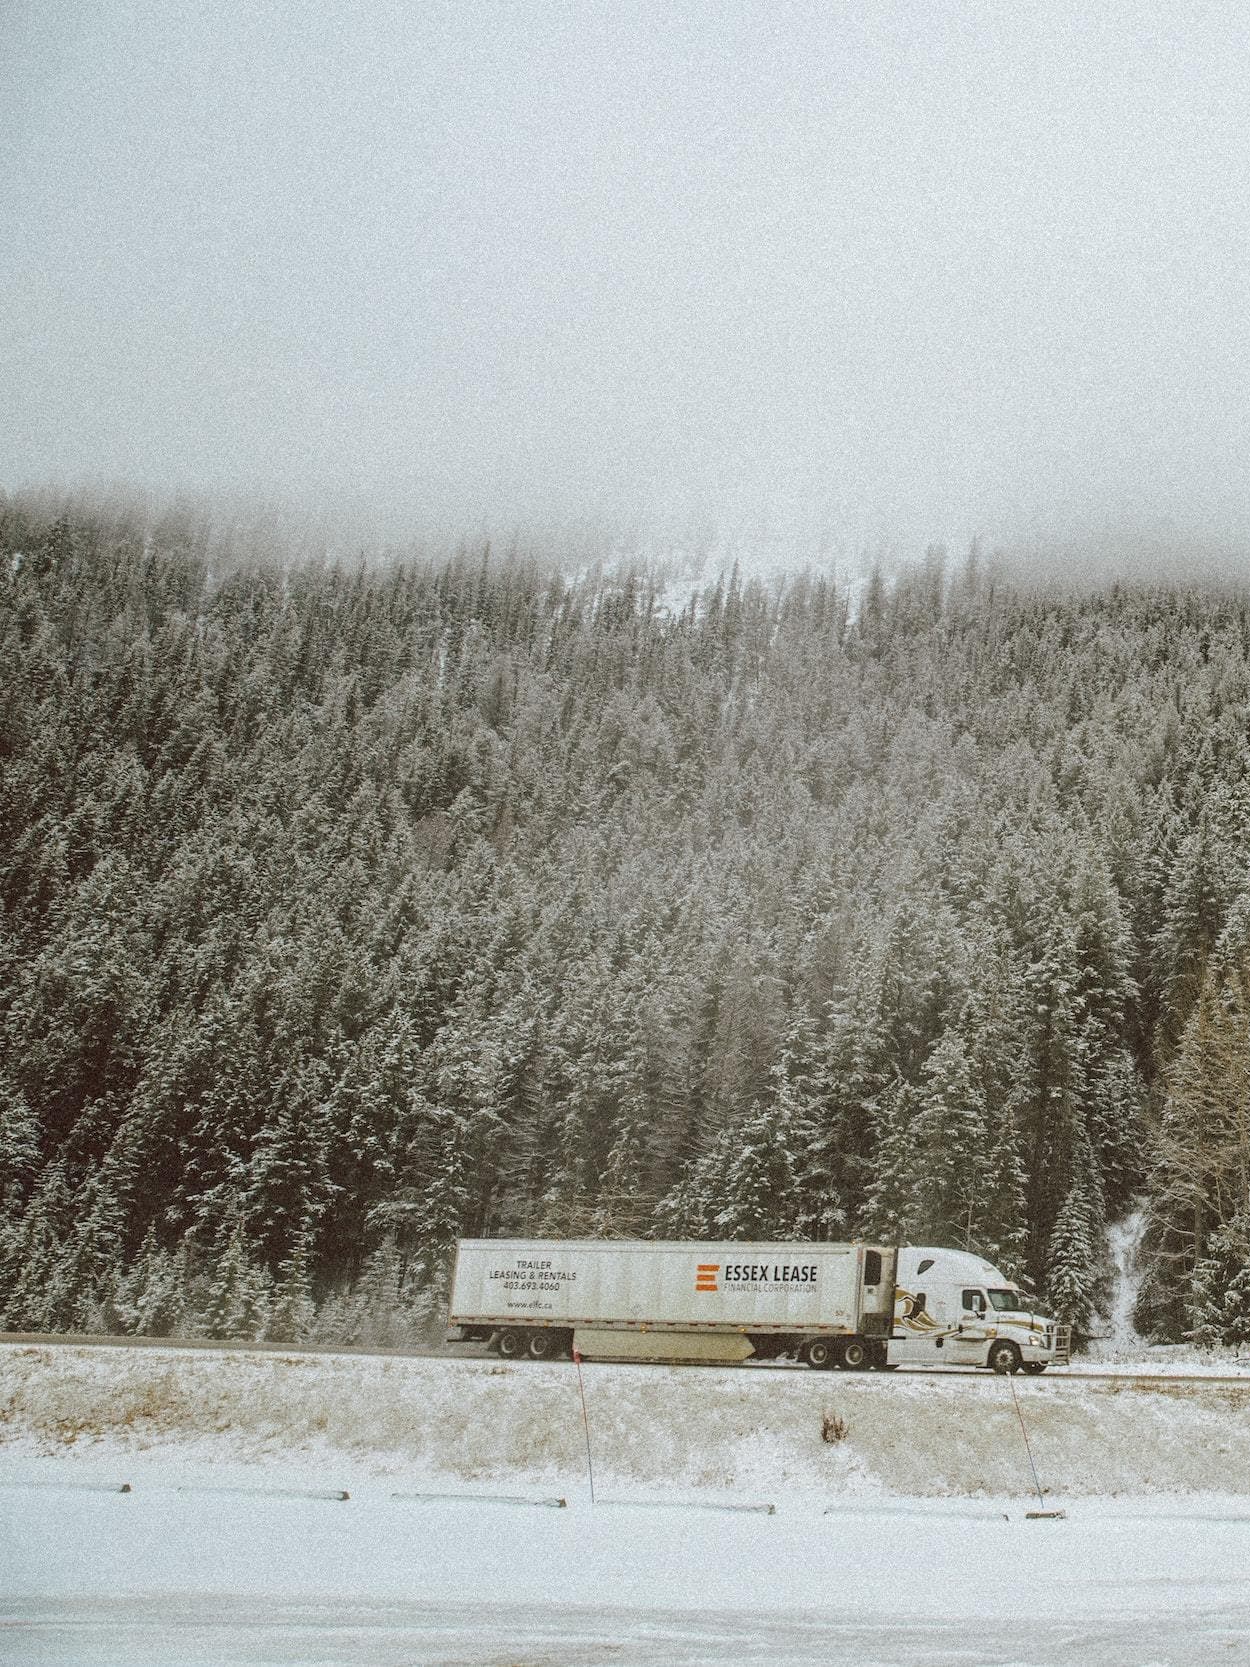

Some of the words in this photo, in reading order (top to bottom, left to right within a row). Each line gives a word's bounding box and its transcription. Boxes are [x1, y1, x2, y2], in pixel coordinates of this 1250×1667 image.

[517, 1261, 552, 1269] TRAILER
[489, 1271, 527, 1279] LEASING
[529, 1271, 535, 1280] &
[538, 1272, 577, 1280] RENTALS
[725, 1265, 768, 1281] ESSEX
[773, 1266, 818, 1281] LEASE
[503, 1281, 560, 1290] 403.693.4060
[724, 1283, 762, 1292] FINANCIAL
[763, 1283, 817, 1293] CORPORATION
